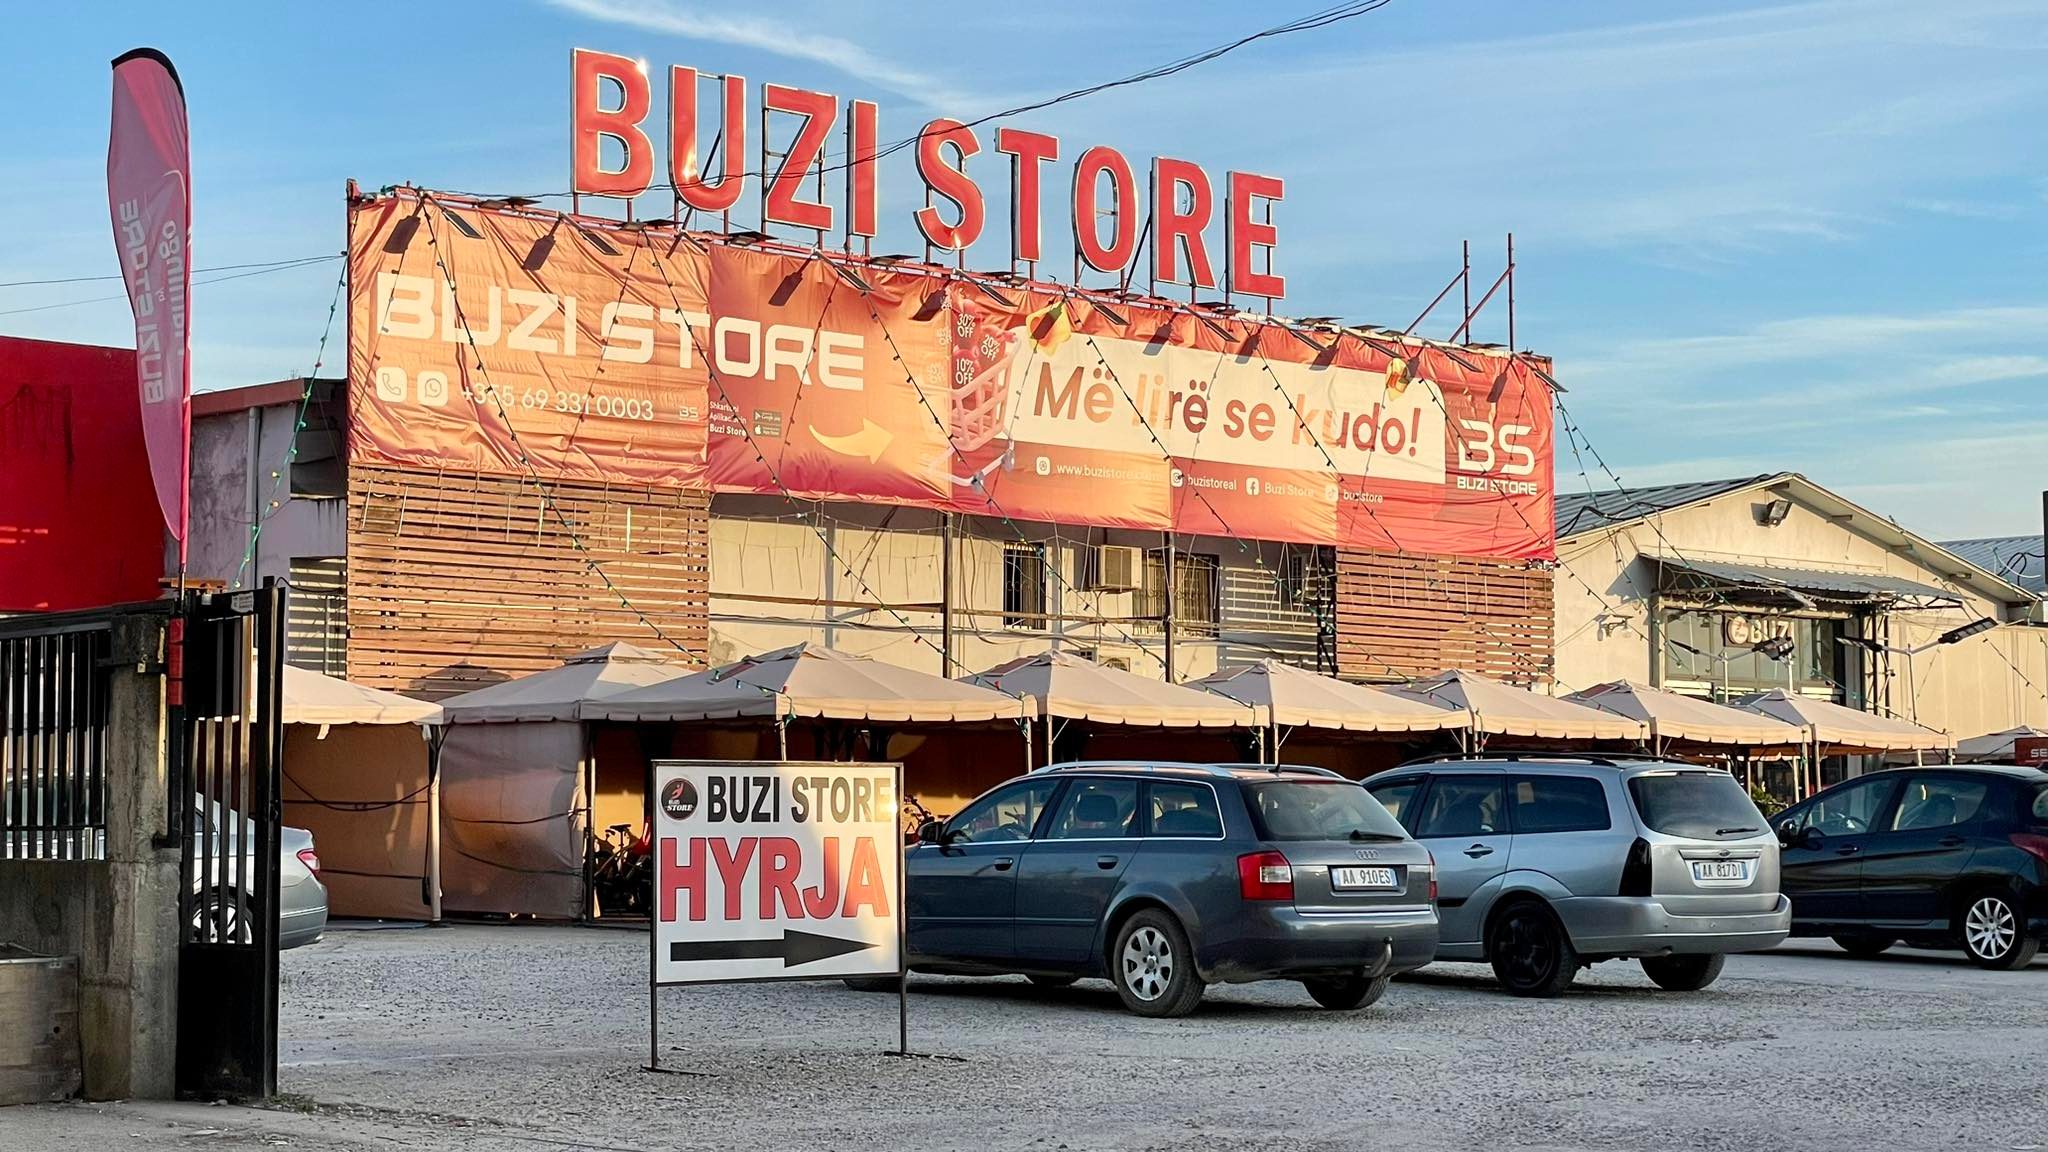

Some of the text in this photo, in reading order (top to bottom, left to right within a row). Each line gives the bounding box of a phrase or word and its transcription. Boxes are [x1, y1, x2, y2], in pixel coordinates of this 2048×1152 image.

[569, 48, 1286, 299] BUZI STORE
[956, 313, 976, 328] 30%
[376, 271, 865, 392] BUZI STORE
[957, 326, 974, 338] OFF
[980, 344, 997, 361] OFF
[981, 334, 1000, 353] 20%
[956, 357, 975, 373] 10%
[955, 371, 973, 385] OFF
[463, 383, 515, 408] +355
[521, 388, 549, 410] 69
[596, 395, 654, 420] 0003
[1033, 361, 1422, 458] Më lirë se kudo!
[709, 423, 726, 434] Buzi
[1458, 418, 1535, 476] BS
[1264, 482, 1286, 495] Buzi
[1457, 475, 1538, 496] BUZI STORE
[707, 775, 893, 824] BUZI STORE
[659, 836, 891, 922] HYRJA
